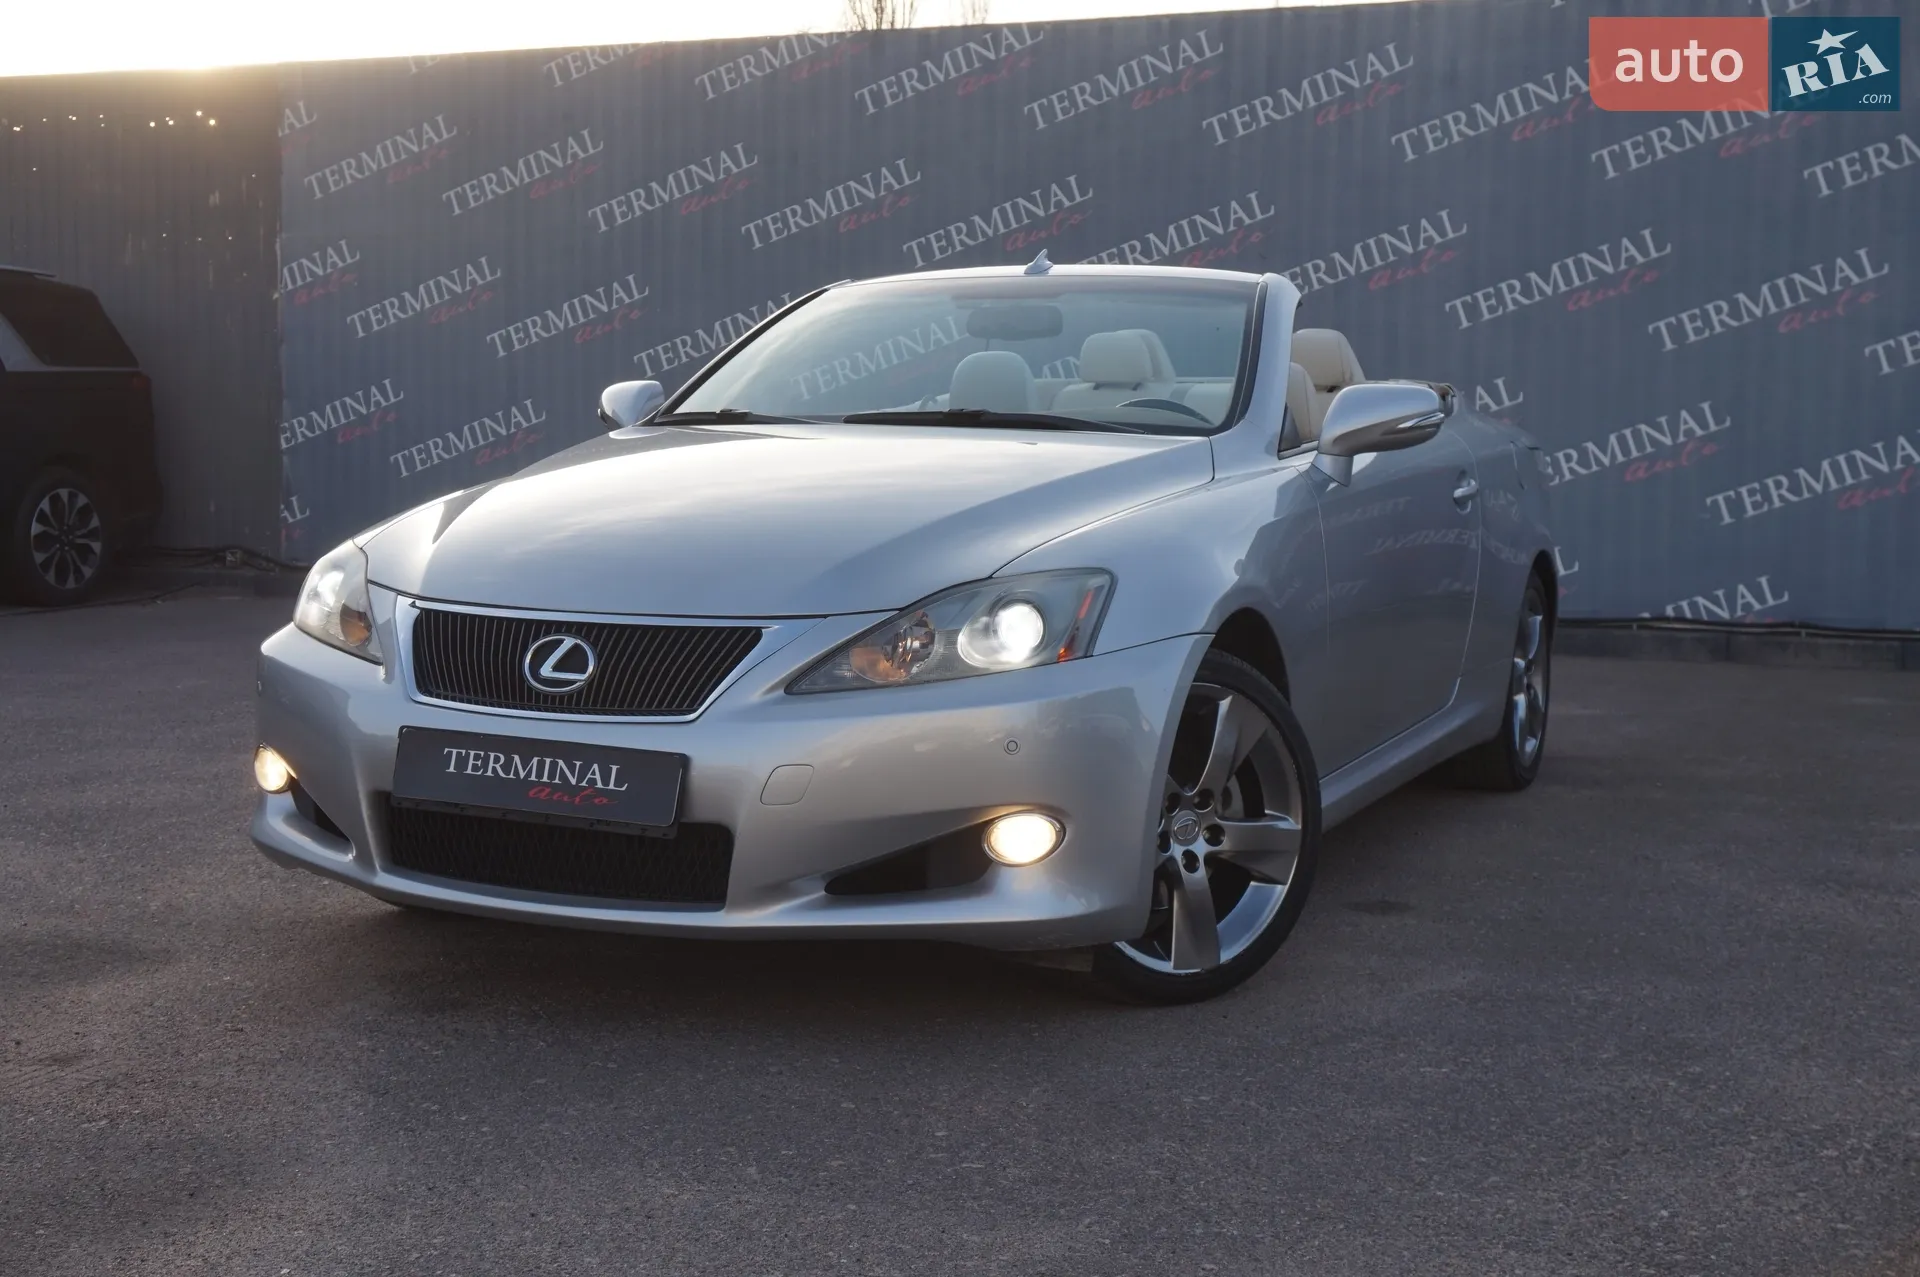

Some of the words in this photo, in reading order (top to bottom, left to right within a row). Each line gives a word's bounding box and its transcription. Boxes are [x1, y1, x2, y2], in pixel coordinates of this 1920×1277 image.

[854, 23, 1044, 115] TERMINAL
[1024, 29, 1224, 130] TERMINAL
[1133, 68, 1218, 109] auto
[1202, 42, 1414, 146] TERMINAL
[1316, 82, 1406, 125] auto
[304, 114, 457, 200] TERMINAL
[442, 128, 604, 216] TERMINAL
[588, 142, 758, 233] TERMINAL
[681, 174, 751, 215] auto
[741, 158, 921, 250] TERMINAL
[839, 193, 914, 233] auto
[903, 174, 1093, 268] TERMINAL
[1006, 210, 1089, 251] auto
[347, 257, 501, 338] TERMINAL
[1369, 247, 1457, 290] auto
[1445, 227, 1672, 330] TERMINAL
[1568, 268, 1661, 311] auto
[430, 289, 493, 324] auto
[486, 273, 649, 358] TERMINAL
[574, 305, 642, 343] auto
[1648, 248, 1890, 352] TERMINAL
[1778, 287, 1878, 333] auto
[390, 398, 547, 477] TERMINAL
[1624, 440, 1720, 481] auto
[443, 747, 628, 792] TERMINAL
[528, 785, 618, 806] auto
